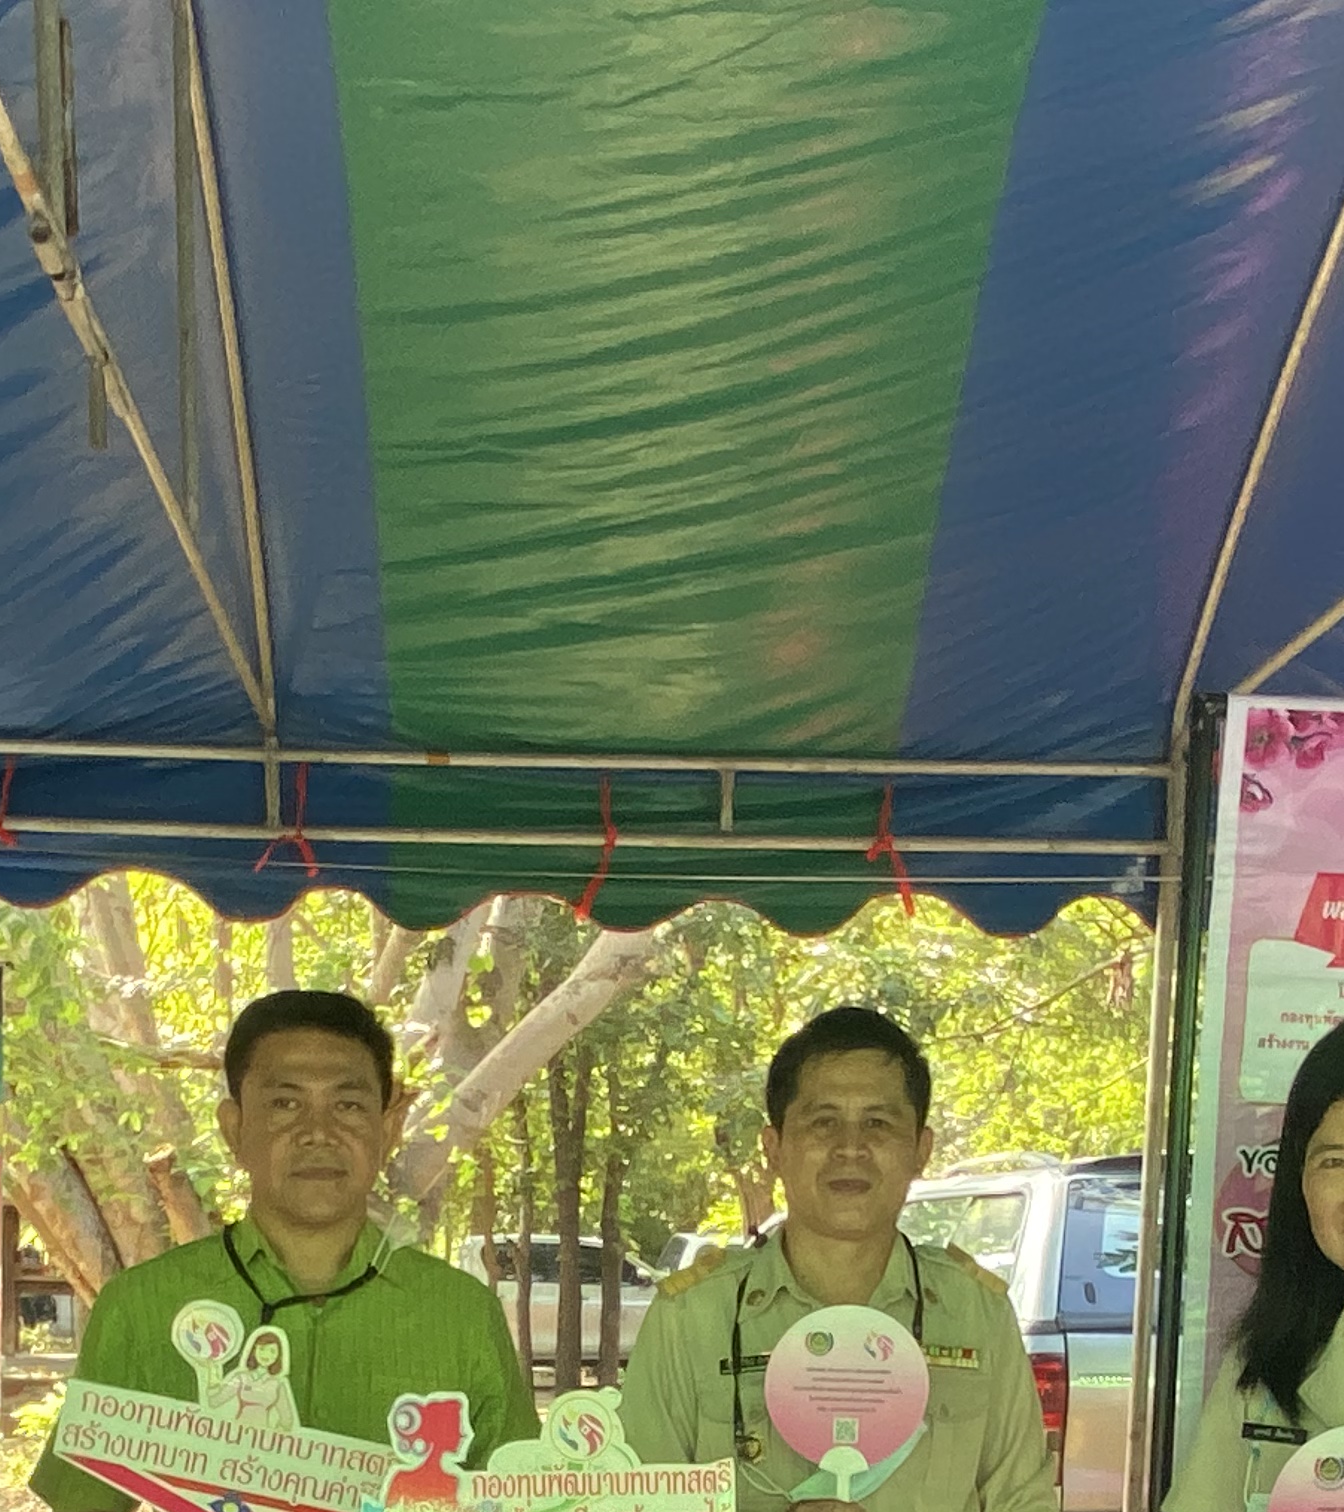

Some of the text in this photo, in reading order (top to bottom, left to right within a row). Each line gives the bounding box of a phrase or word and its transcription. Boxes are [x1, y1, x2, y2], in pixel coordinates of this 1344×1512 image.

[62, 1421, 208, 1475] สร้างบทบาท
[472, 1462, 731, 1498] กองทุนพัฒนาบทบาทสตรี
